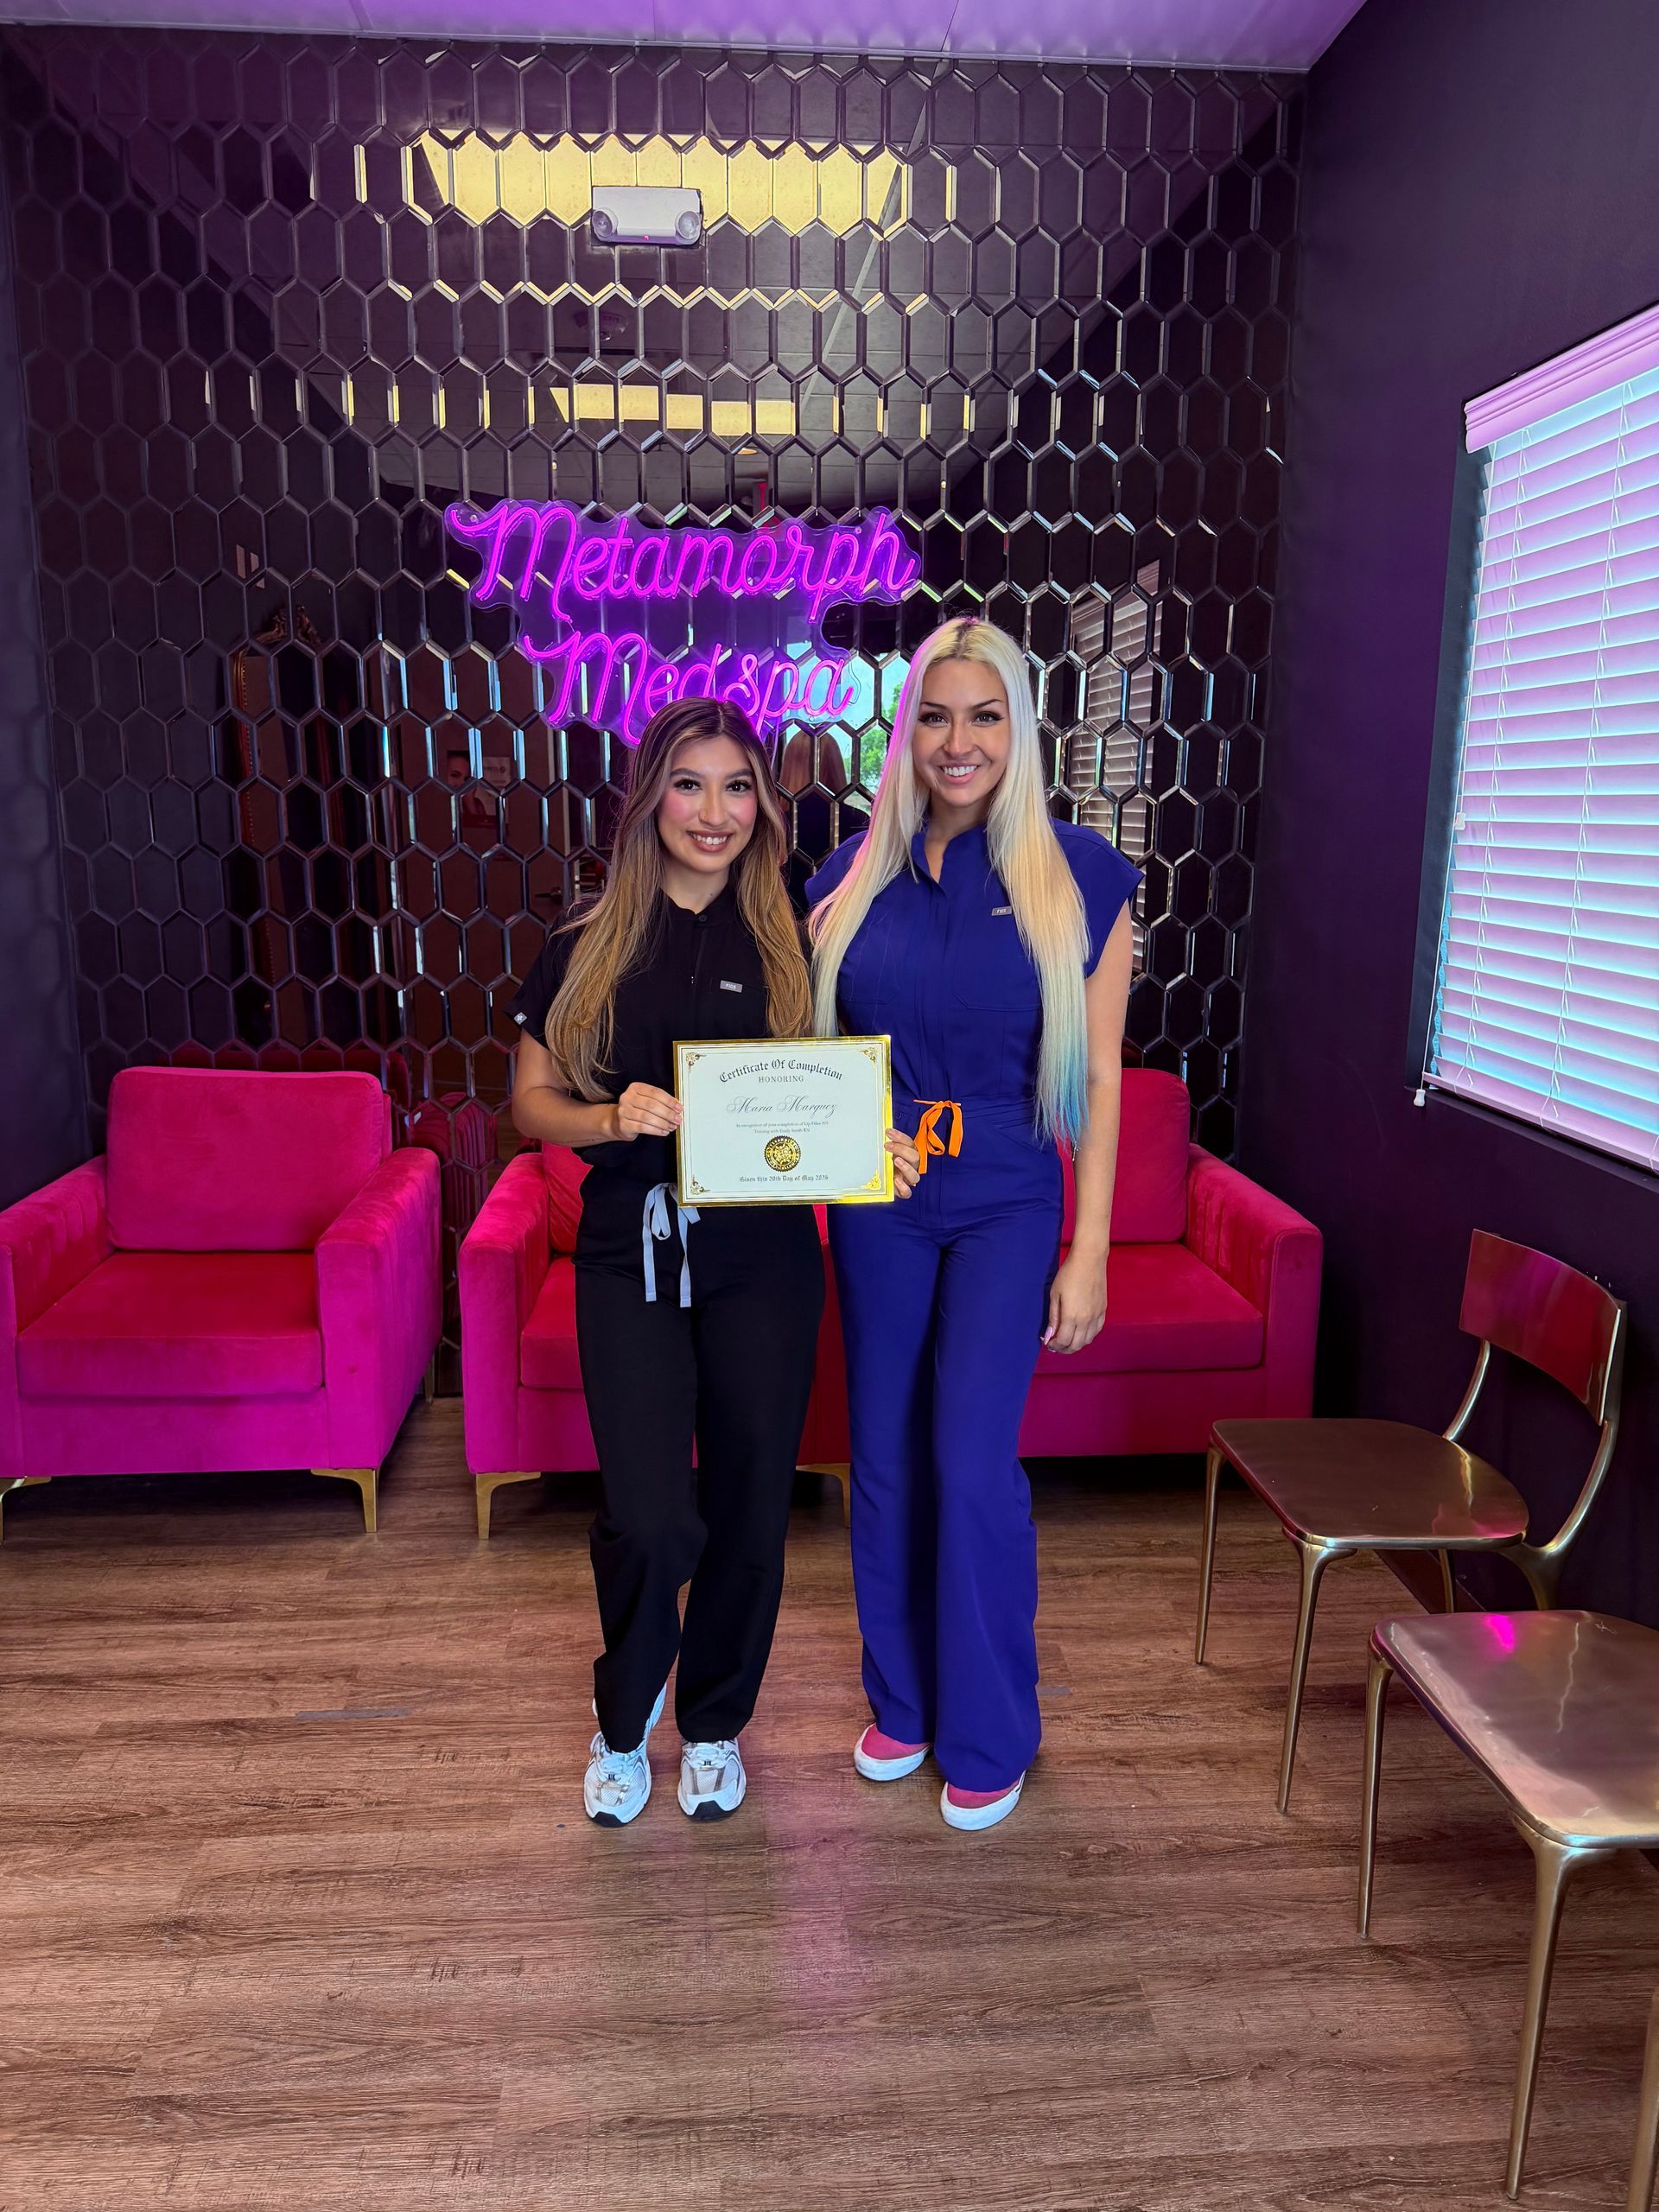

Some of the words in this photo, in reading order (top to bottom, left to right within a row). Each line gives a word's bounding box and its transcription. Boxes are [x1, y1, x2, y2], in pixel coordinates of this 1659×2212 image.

[450, 505, 916, 624] Metamorph
[524, 631, 854, 746] Medspa
[719, 1062, 769, 1083] Certificate
[772, 1058, 785, 1070] Of
[788, 1059, 842, 1081] Completion
[726, 1096, 773, 1114] Maria
[777, 1094, 837, 1119] Marquez
